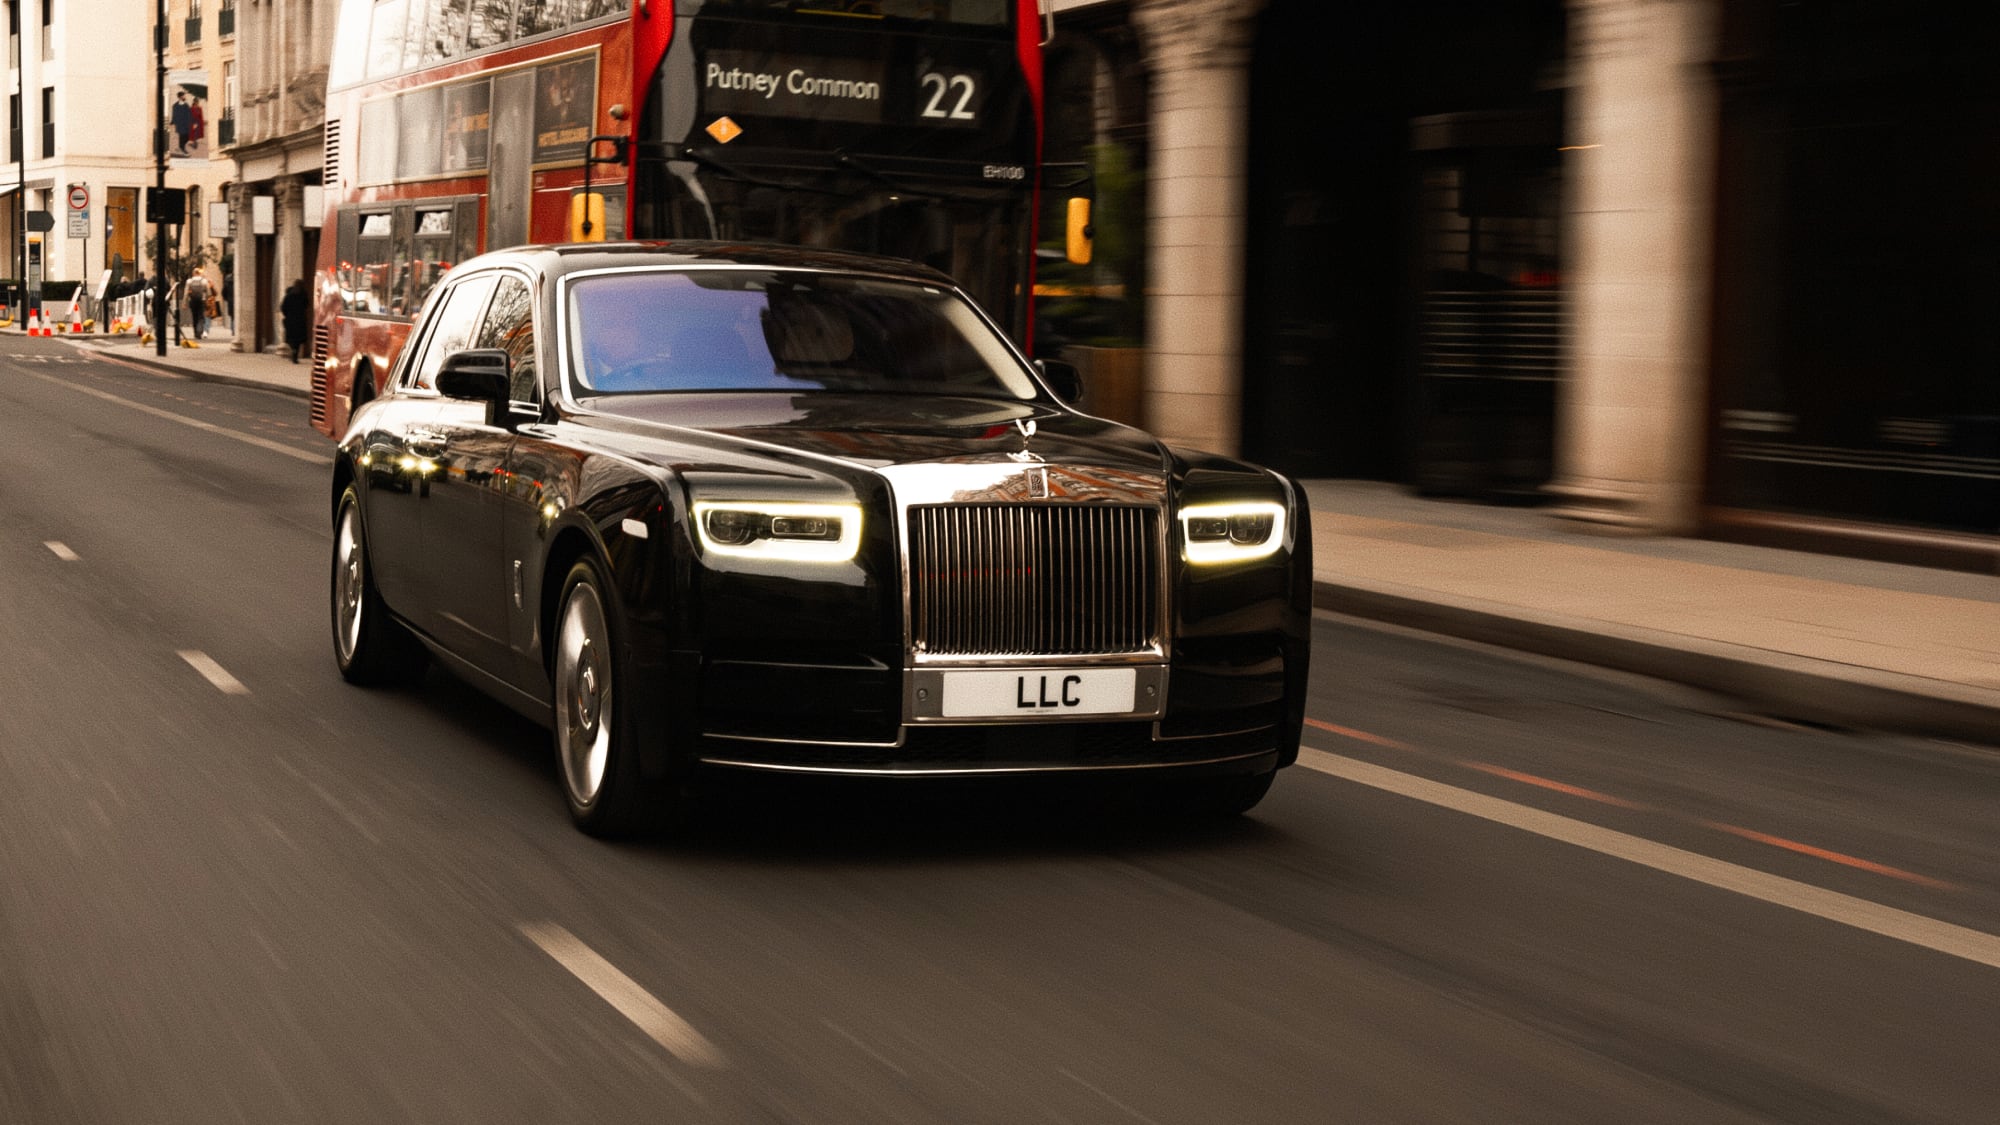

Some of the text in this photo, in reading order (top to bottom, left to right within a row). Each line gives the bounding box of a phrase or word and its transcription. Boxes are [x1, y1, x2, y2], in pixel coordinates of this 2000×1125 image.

[706, 62, 880, 100] Putney Common
[921, 73, 976, 120] 22
[1016, 674, 1082, 709] LLC
